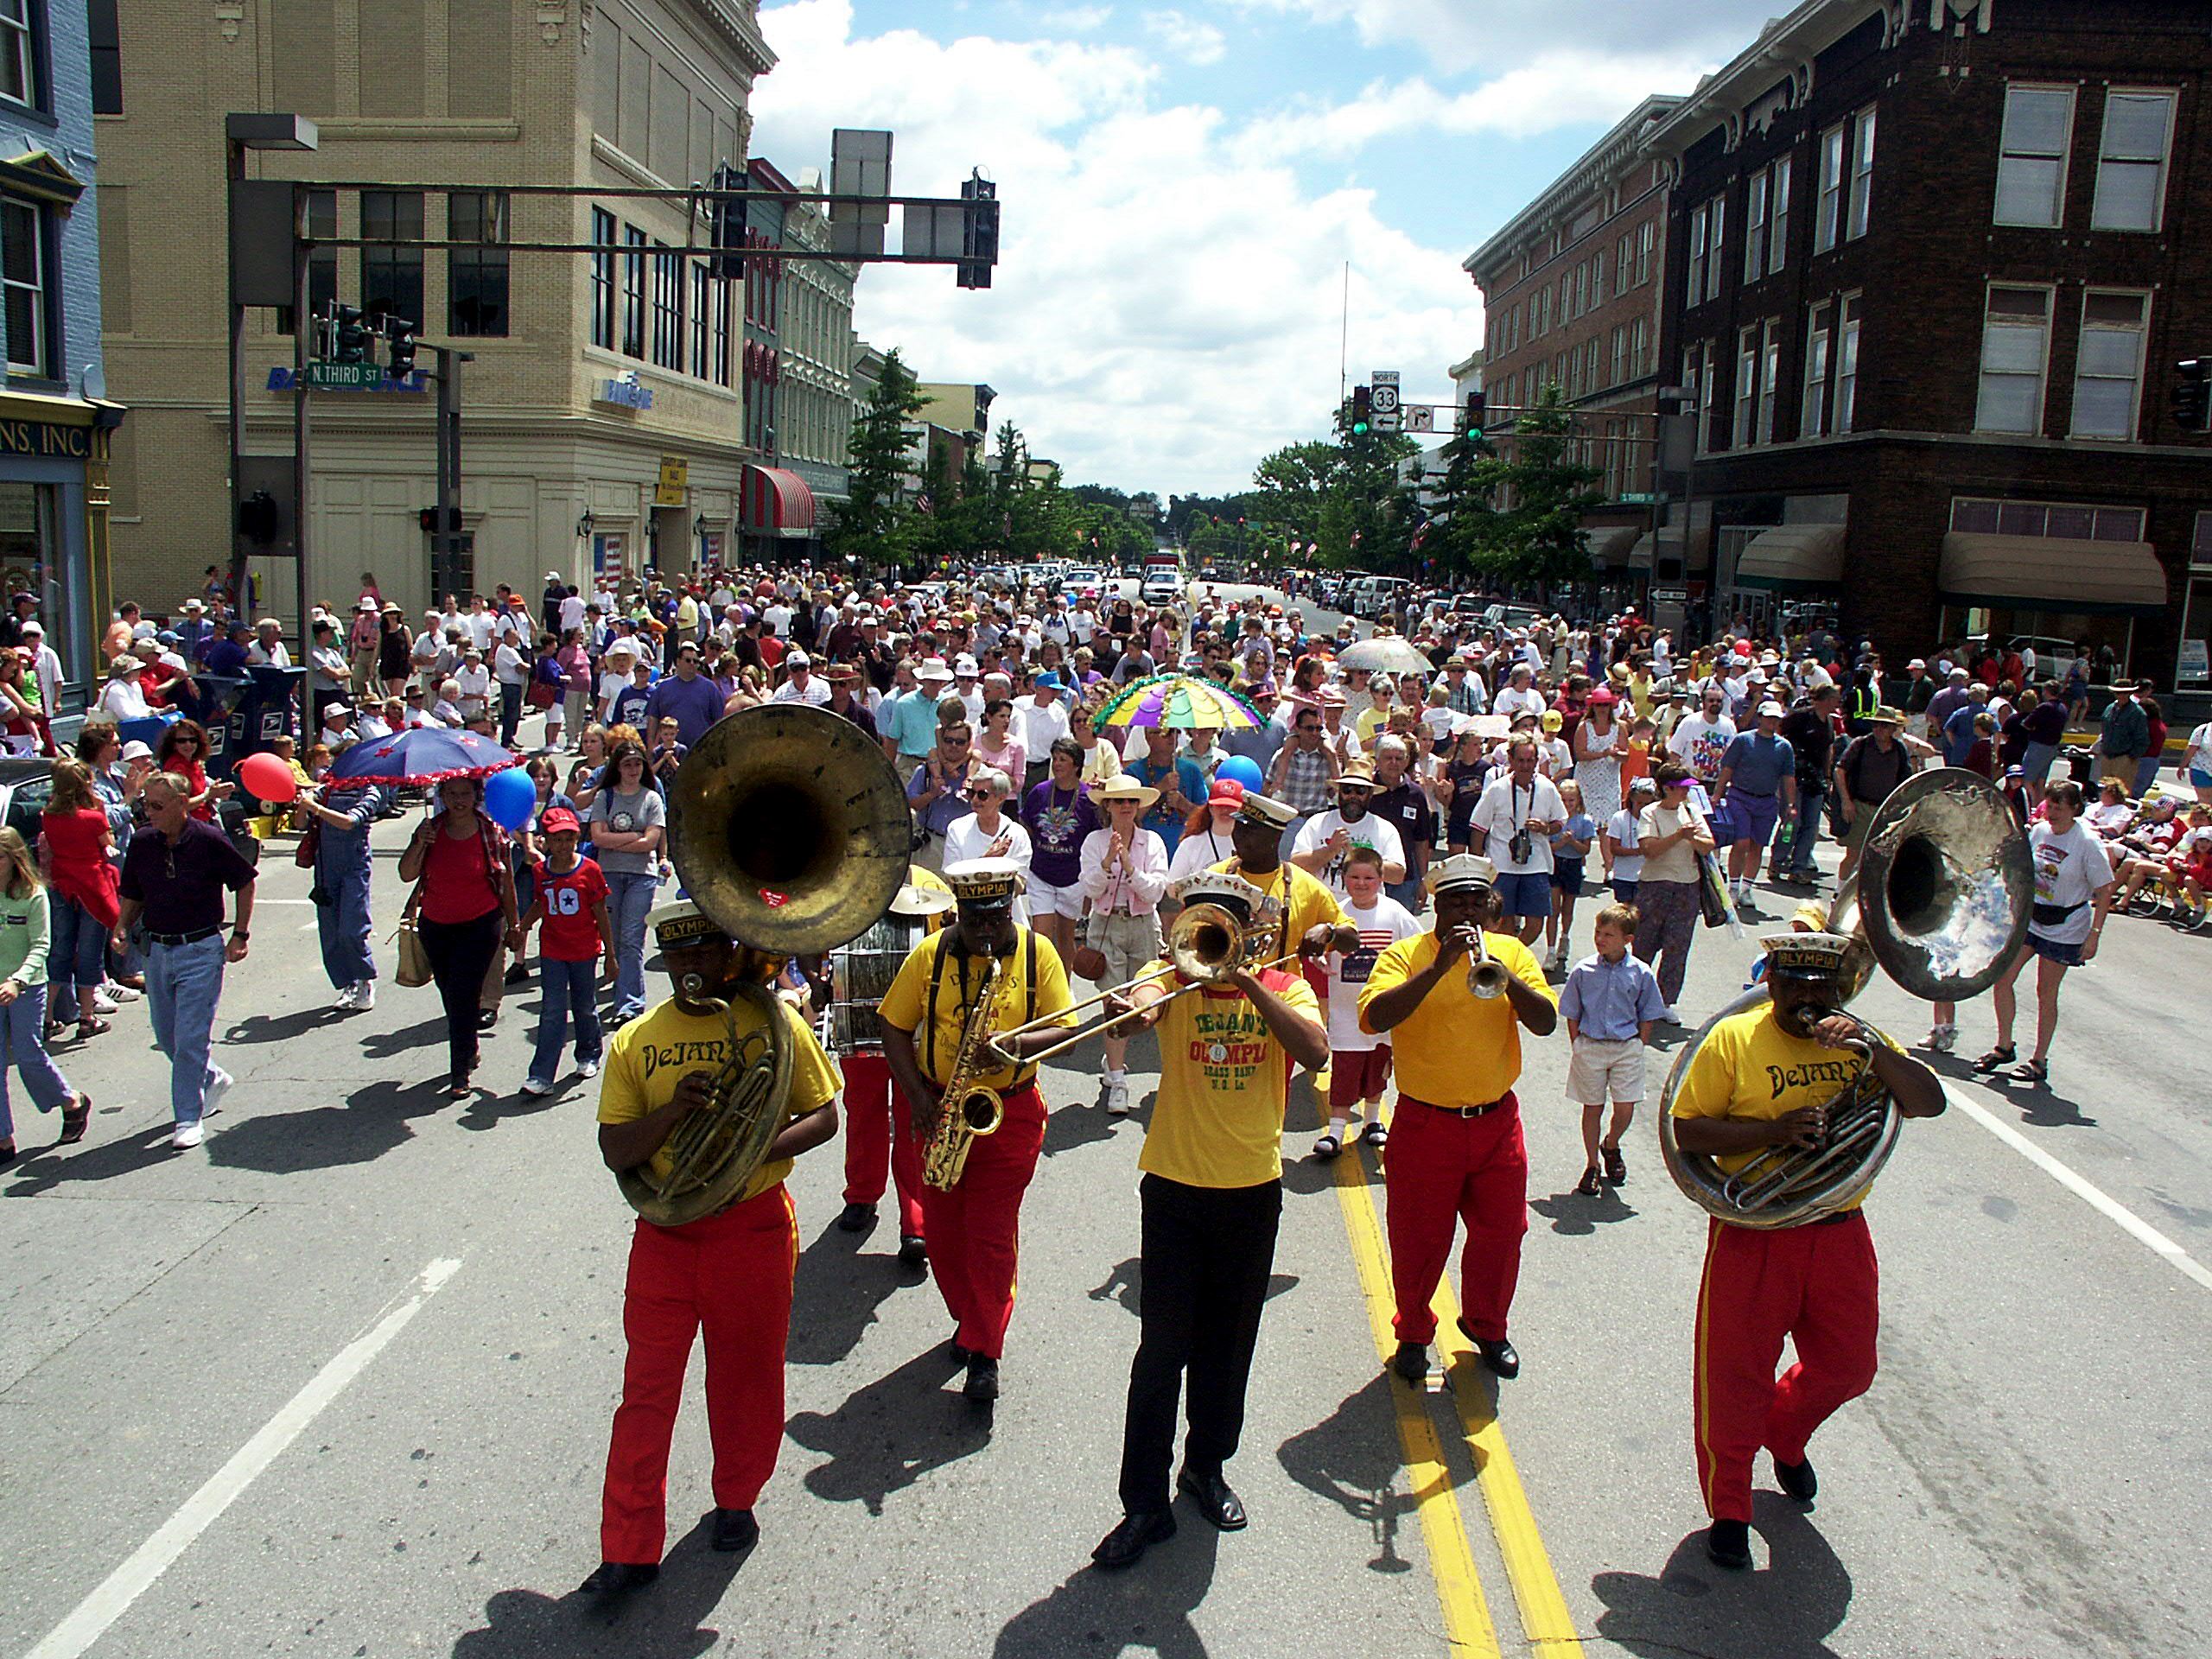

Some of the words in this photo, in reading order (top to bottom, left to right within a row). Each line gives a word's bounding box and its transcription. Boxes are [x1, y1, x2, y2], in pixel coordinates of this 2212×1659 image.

[365, 370, 377, 381] ST
[1376, 391, 1395, 407] 33
[41, 423, 88, 456] INC.
[959, 883, 1006, 897] OLYMPIA
[544, 887, 580, 915] 10
[1780, 951, 1836, 967] OLYMPIA
